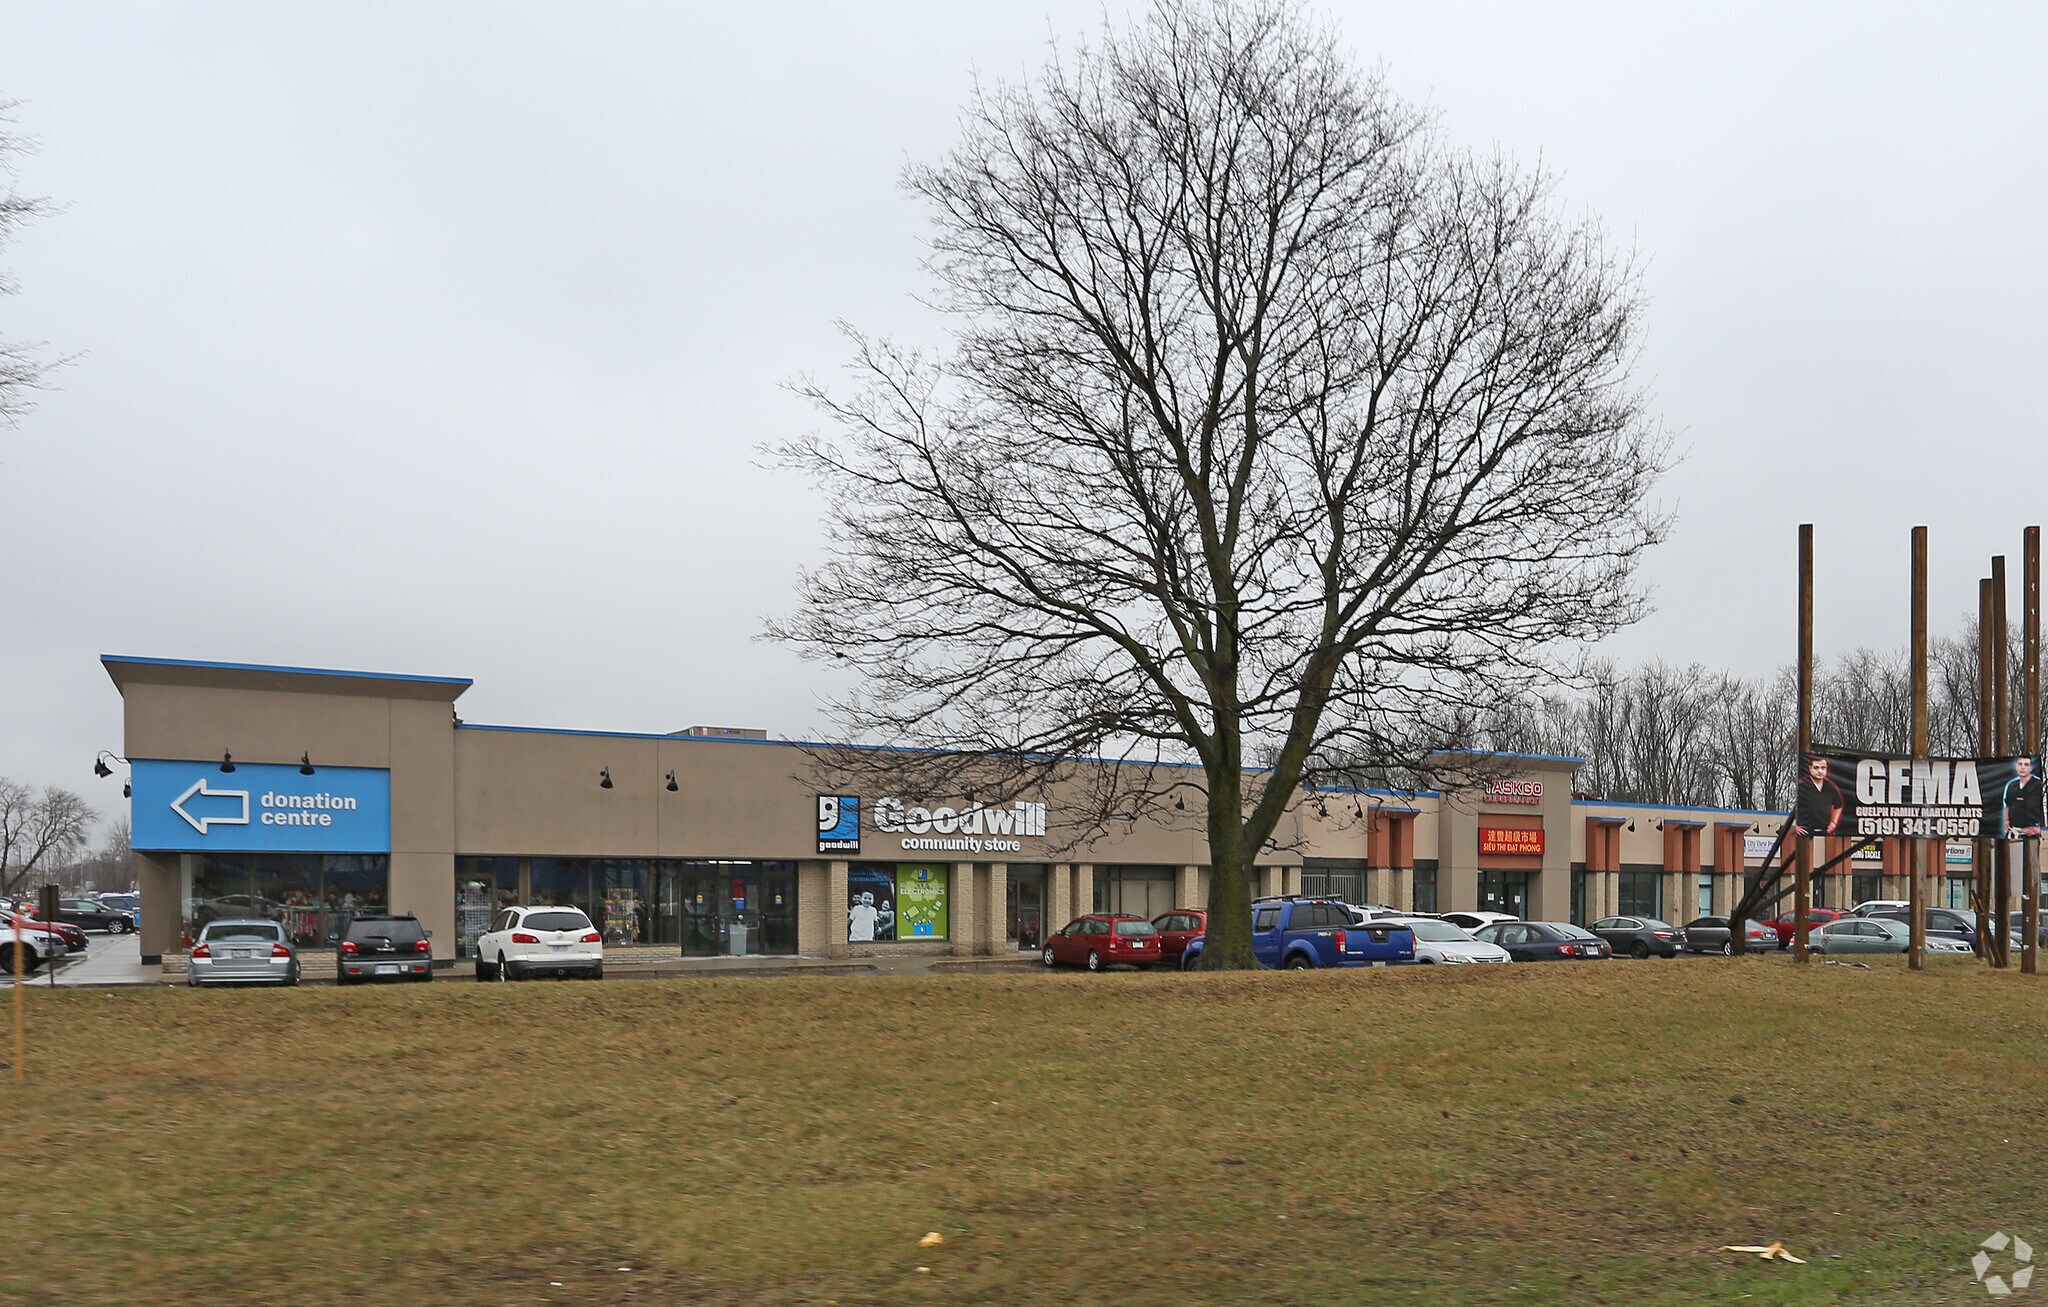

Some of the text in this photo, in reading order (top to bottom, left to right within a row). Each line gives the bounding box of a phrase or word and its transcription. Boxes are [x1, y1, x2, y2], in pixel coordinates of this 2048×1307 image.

[1856, 759, 1982, 806] GFMA
[261, 791, 357, 810] donation
[261, 810, 332, 827] centre
[873, 796, 1046, 836] Goodwill
[1856, 806, 1983, 818] GUELPH FAMILY MARTIAL ARTS
[1858, 818, 1980, 836] (519) 341-0550
[819, 841, 859, 851] goodwill
[901, 836, 1021, 854] community store
[1519, 844, 1541, 852] PHONG
